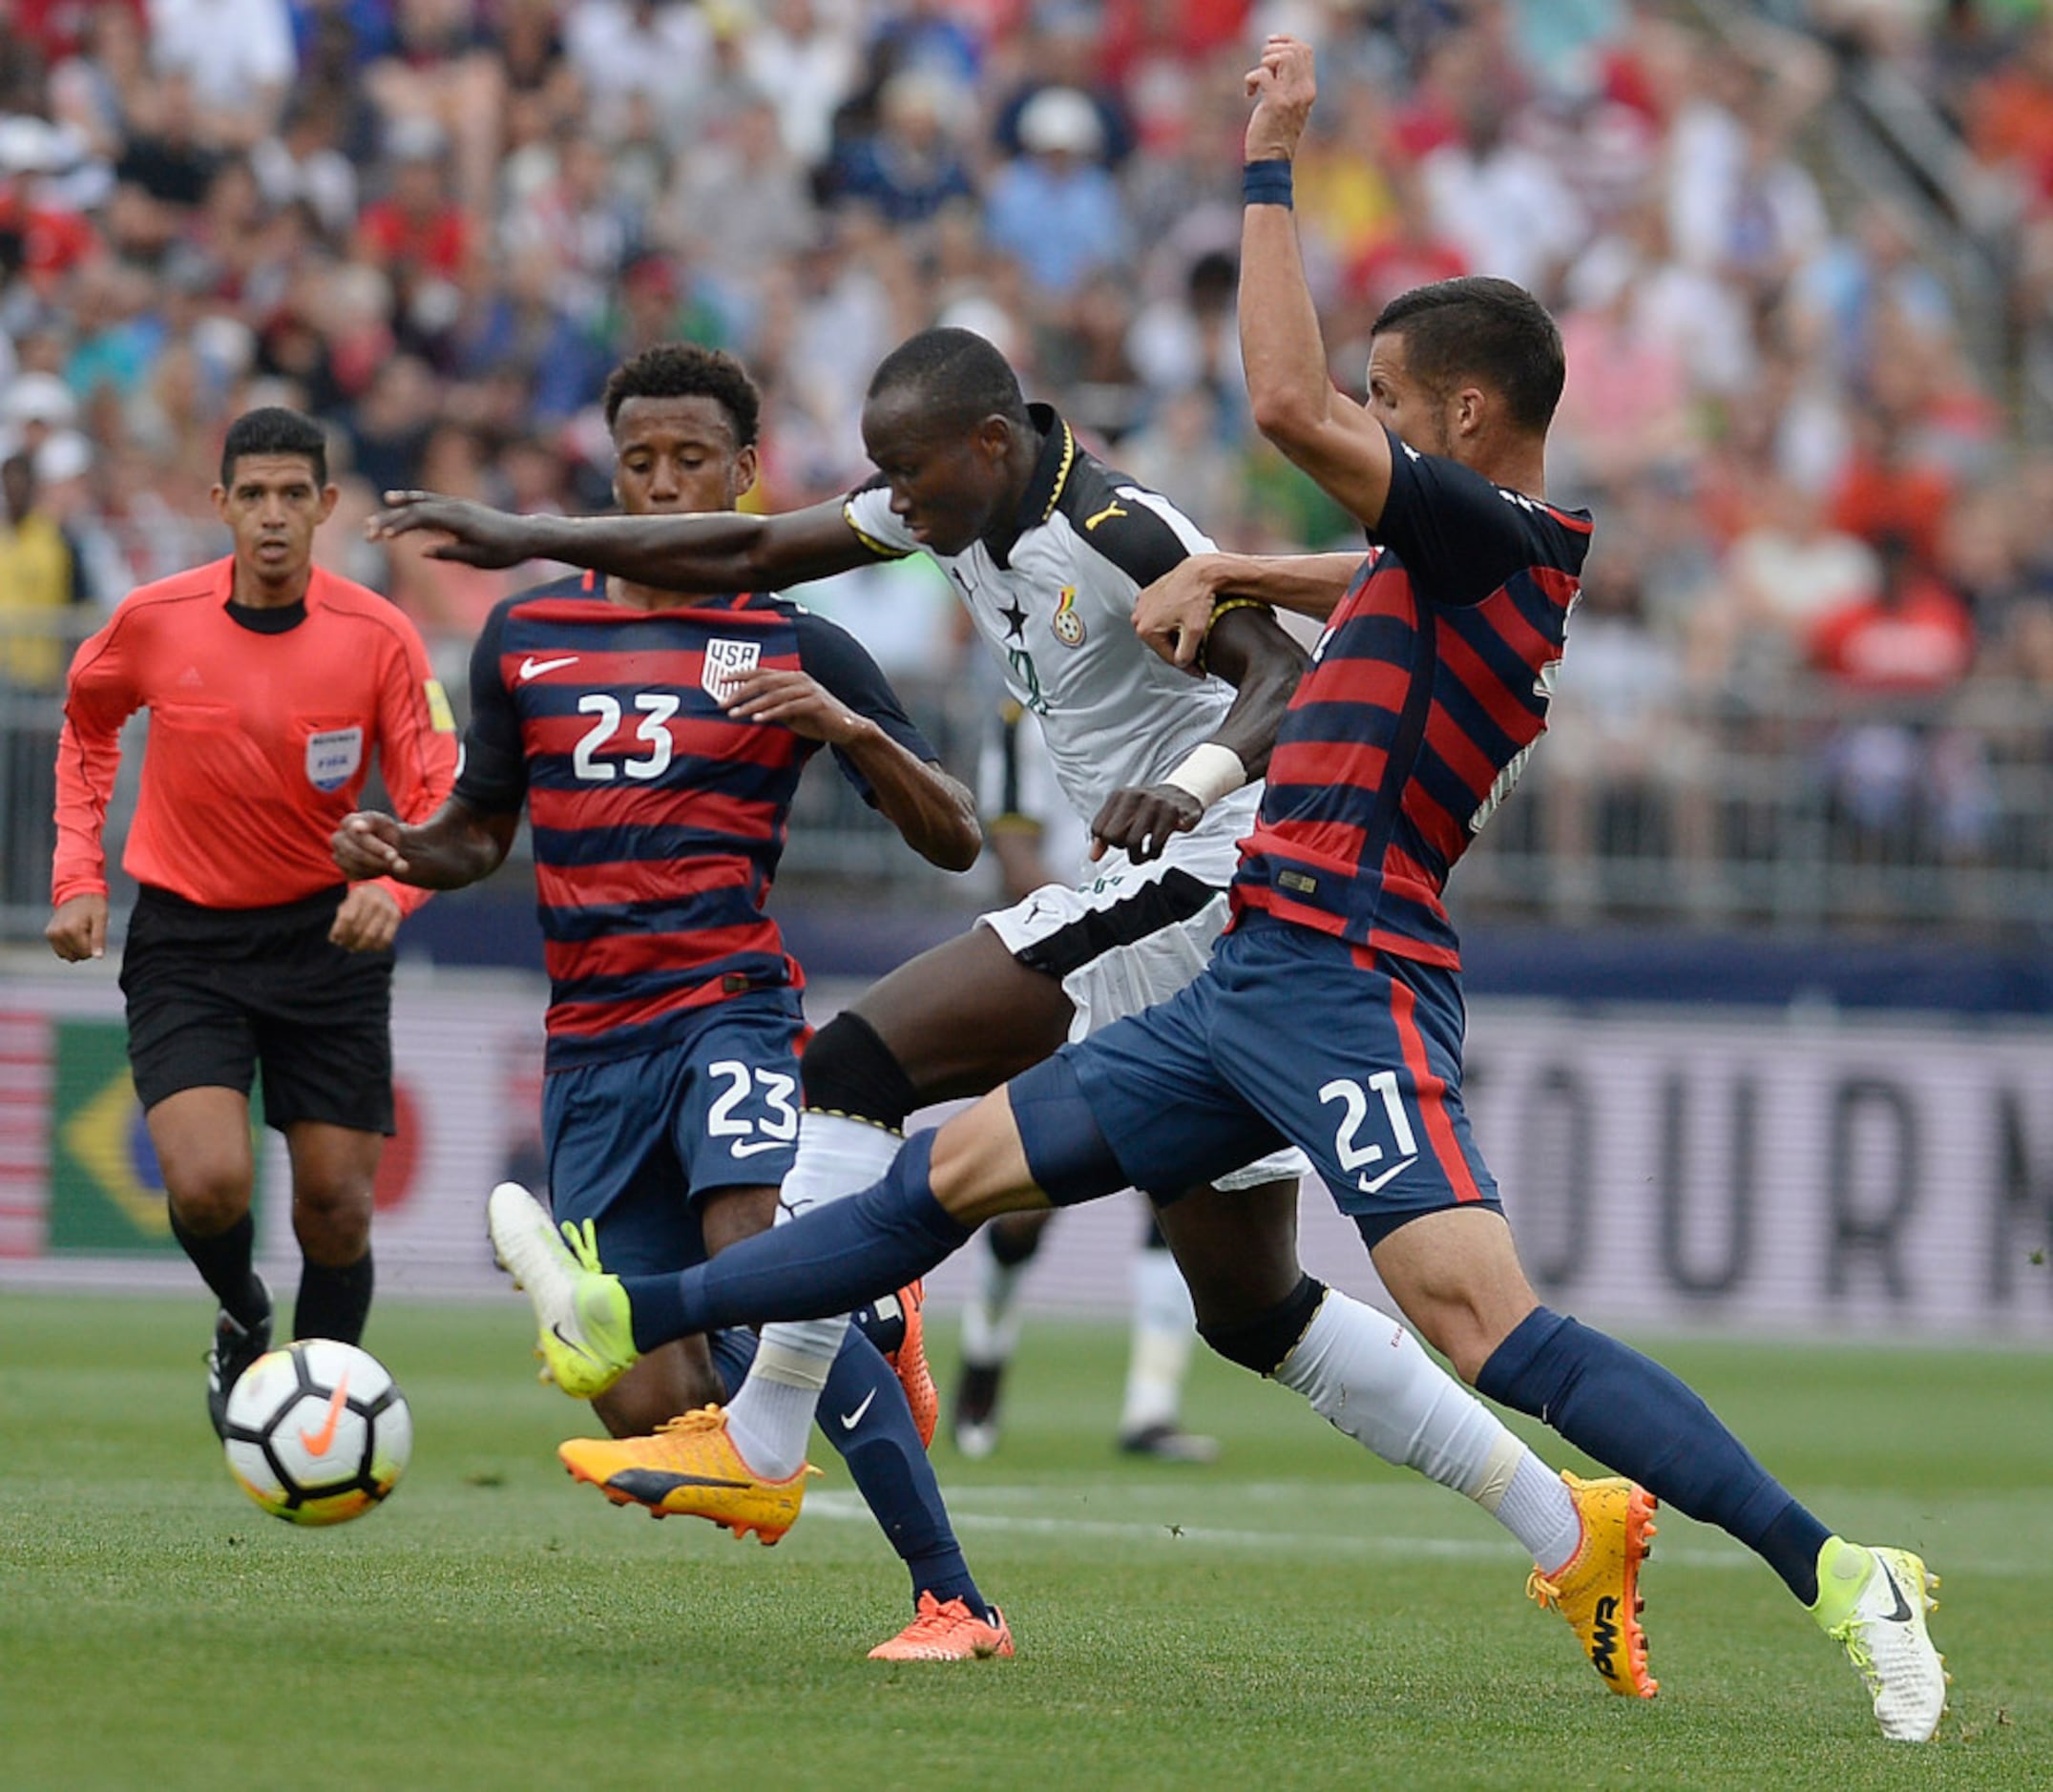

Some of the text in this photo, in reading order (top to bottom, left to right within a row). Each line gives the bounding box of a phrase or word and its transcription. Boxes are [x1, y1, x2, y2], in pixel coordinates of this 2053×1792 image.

[711, 643, 754, 667] USA
[575, 694, 681, 780] 23
[708, 1060, 798, 1140] 23
[1318, 1070, 1418, 1173] 21
[1463, 1057, 2053, 1305] OURN
[1592, 1595, 1620, 1681] PWR
